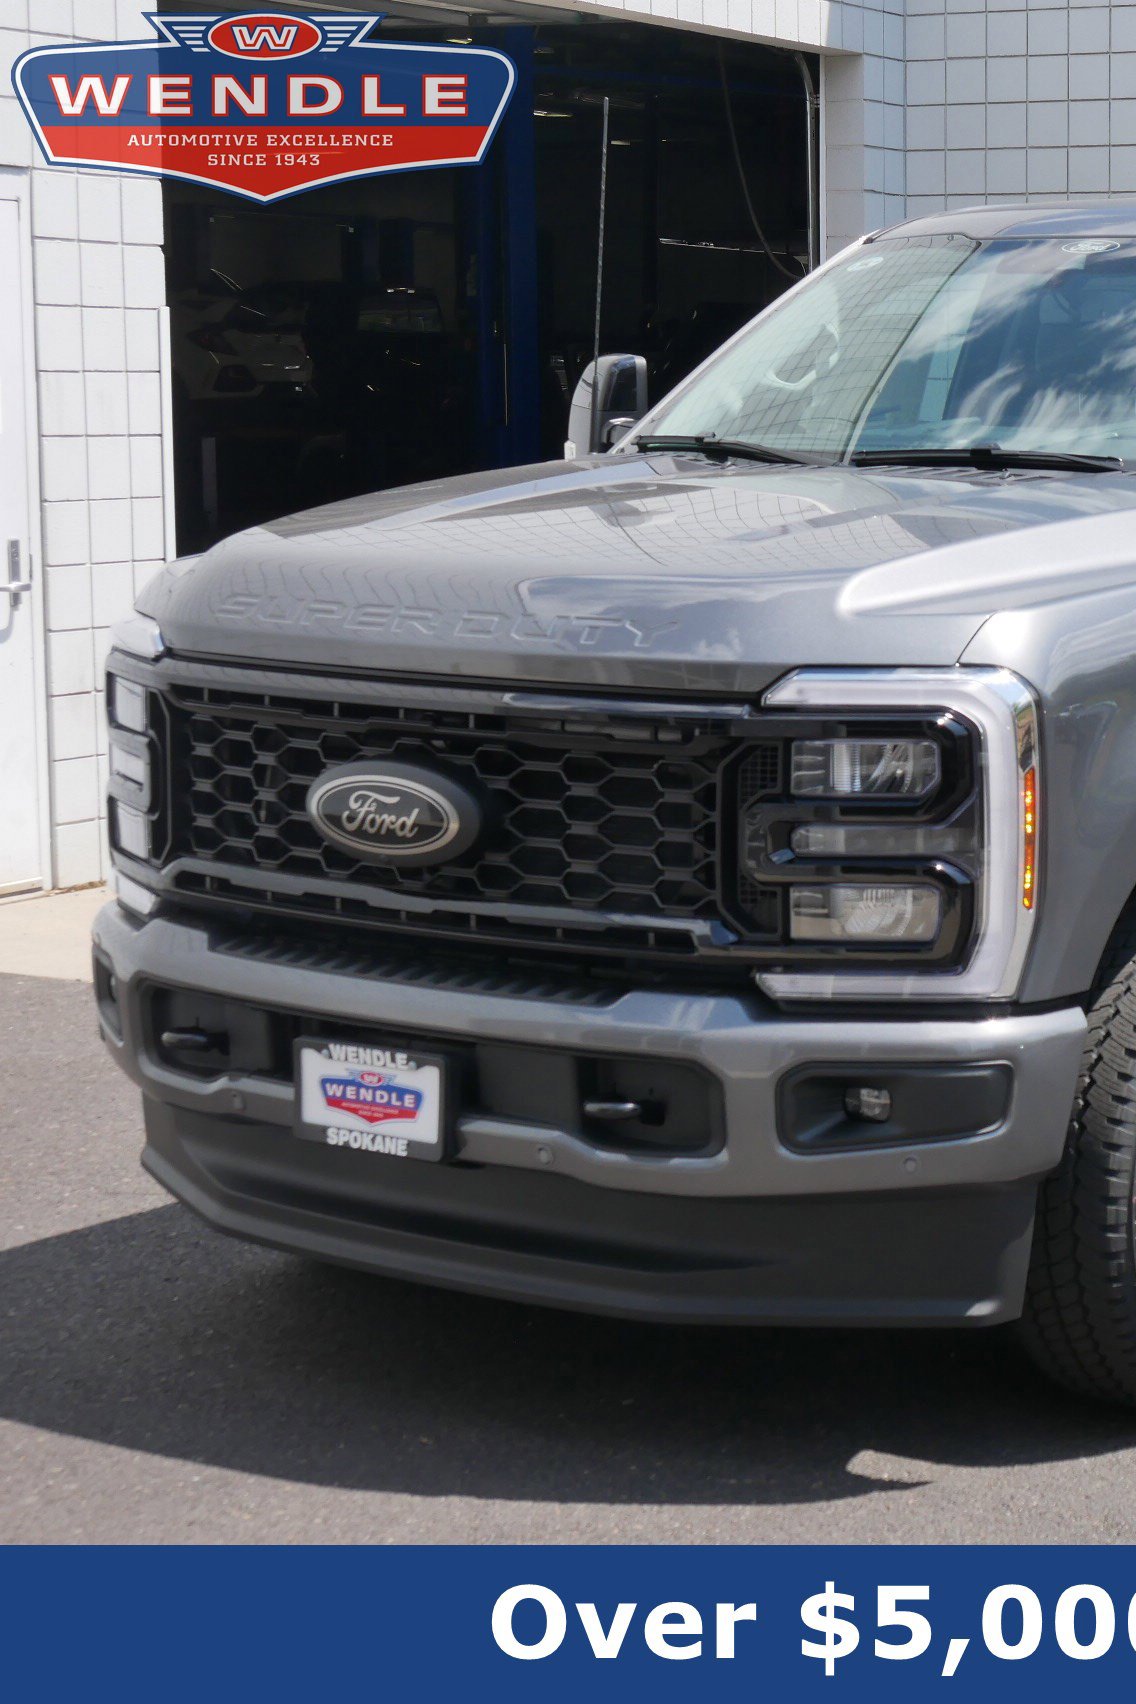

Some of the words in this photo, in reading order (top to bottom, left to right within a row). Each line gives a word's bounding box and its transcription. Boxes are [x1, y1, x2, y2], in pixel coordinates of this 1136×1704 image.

[213, 592, 444, 636] SUPER
[452, 610, 679, 648] DUTY
[341, 790, 420, 838] Ford
[328, 1043, 409, 1070] WENDLE
[325, 1082, 417, 1109] WENDLE
[326, 1126, 408, 1157] SPOKANE
